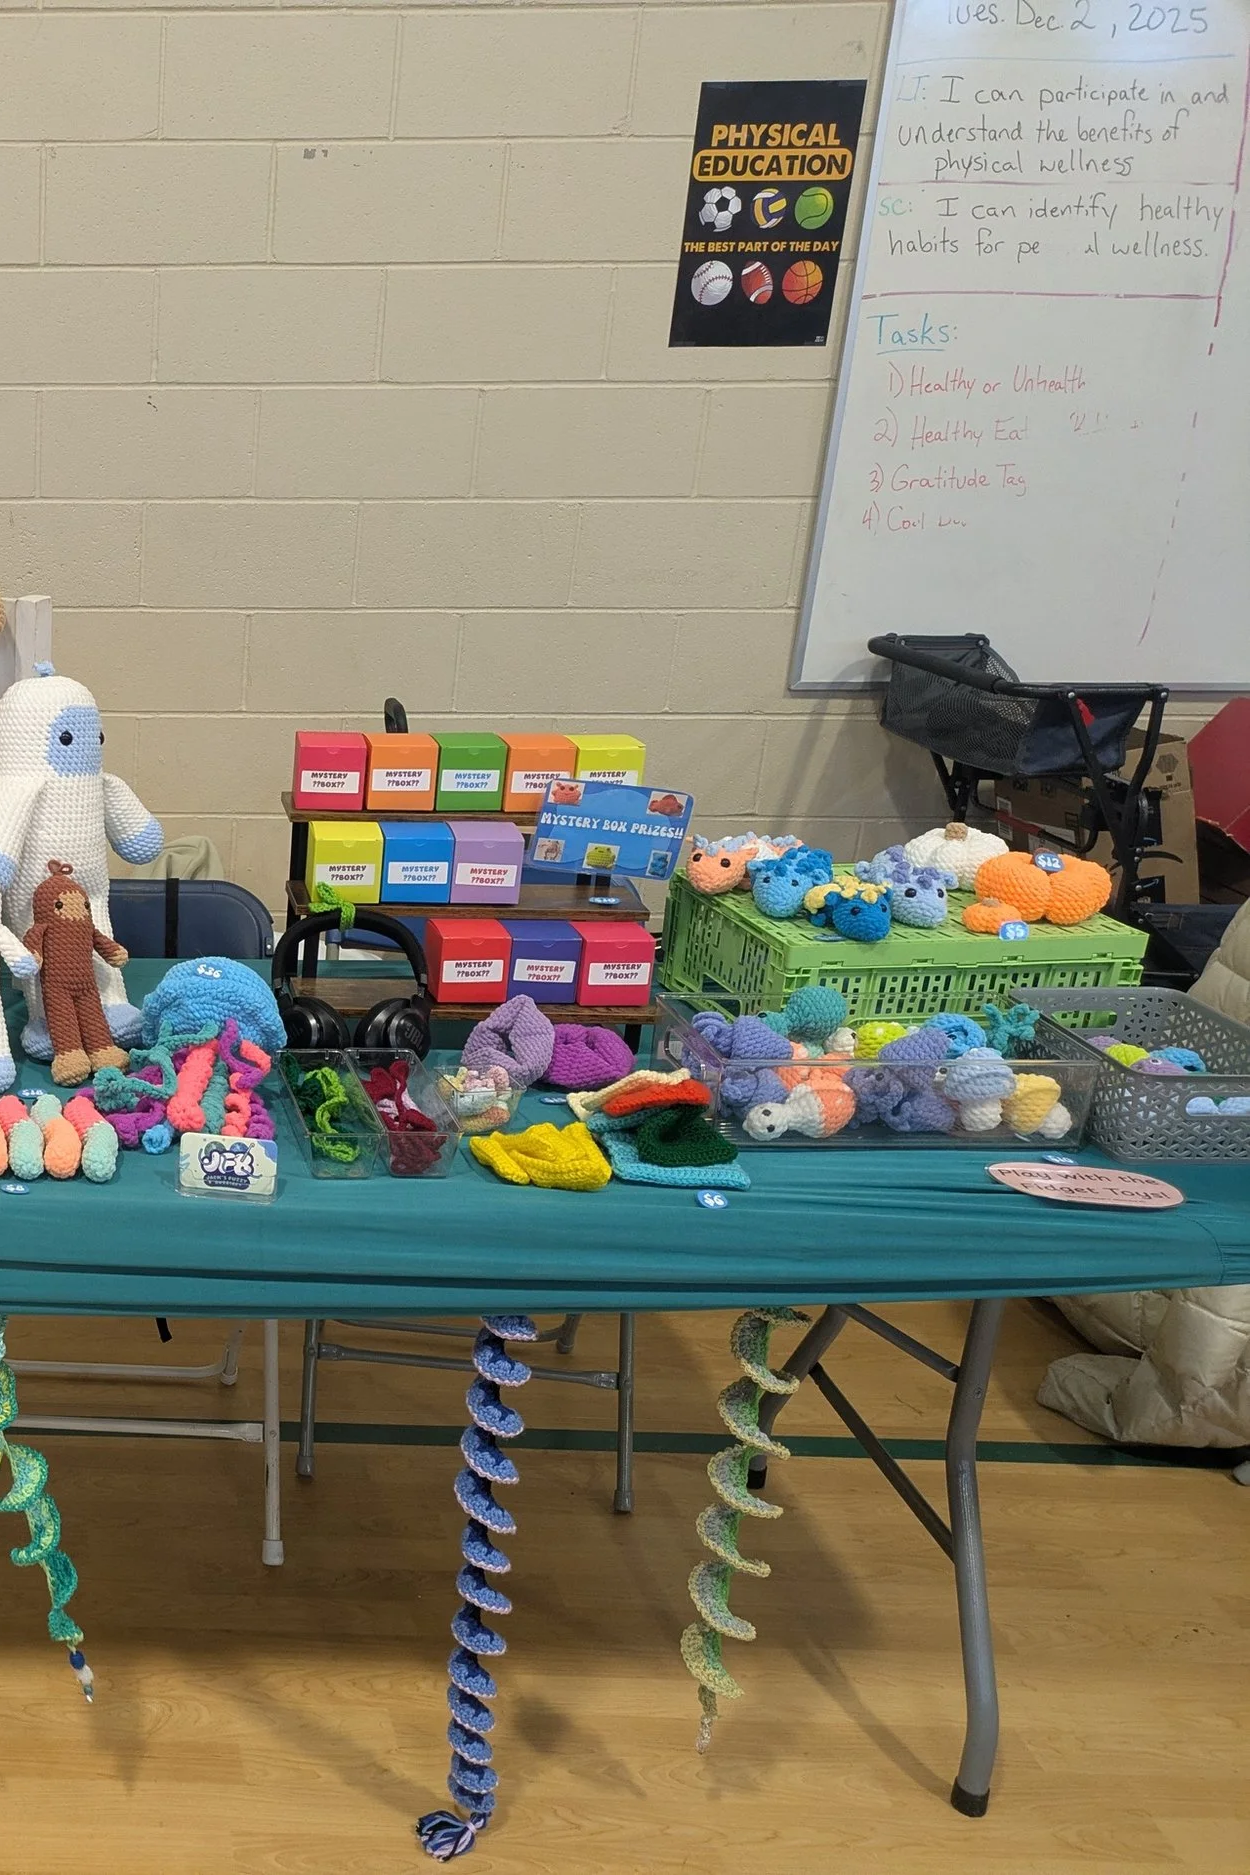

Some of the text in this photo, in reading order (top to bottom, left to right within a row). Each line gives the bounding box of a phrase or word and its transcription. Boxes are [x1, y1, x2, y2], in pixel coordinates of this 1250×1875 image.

[1016, 0, 1064, 31] Dec.
[1129, 3, 1208, 34] 2025
[939, 75, 964, 104] I
[974, 88, 1024, 104] can
[1039, 75, 1150, 110] participate
[1159, 83, 1175, 104] in
[1191, 83, 1229, 104] and
[710, 123, 841, 147] PHYSICAL
[898, 107, 1190, 146] understand the benefits of
[697, 154, 848, 177] EDUCATION
[934, 148, 1135, 180] physical wellness
[936, 196, 959, 217] I
[970, 204, 1017, 219] can
[1029, 192, 1118, 230] identify
[1139, 192, 1224, 232] healthy
[683, 240, 840, 253] THE BEST PART OF THE DAY
[888, 226, 960, 256] habits
[974, 226, 1005, 256] for
[1111, 230, 1209, 258] wellness.
[865, 313, 958, 346] Tasks:
[909, 364, 977, 400] Healthy
[982, 381, 1002, 394] or
[873, 406, 899, 447] 2)
[909, 415, 984, 450] Healthy
[868, 462, 1028, 497] 3) Gratitude Tag
[456, 781, 489, 789] ??BOX??
[540, 812, 601, 830] MYSTERY
[602, 819, 628, 832] BOX
[1037, 854, 1061, 869] $12
[402, 874, 437, 882] ??BOX??
[469, 867, 509, 876] MYSTERY
[470, 876, 505, 885] ??BOX??
[454, 961, 493, 969] MYSTERY
[456, 970, 491, 978] ??BOX??
[526, 964, 565, 972] MYSTERY
[602, 963, 642, 971] MYSTERY
[527, 973, 561, 981] ??BOX??
[604, 972, 639, 980] ??BOX??
[997, 1168, 1159, 1186] Play with the
[1020, 1181, 1100, 1195] Fidget
[1102, 1187, 1171, 1200] Toys!
